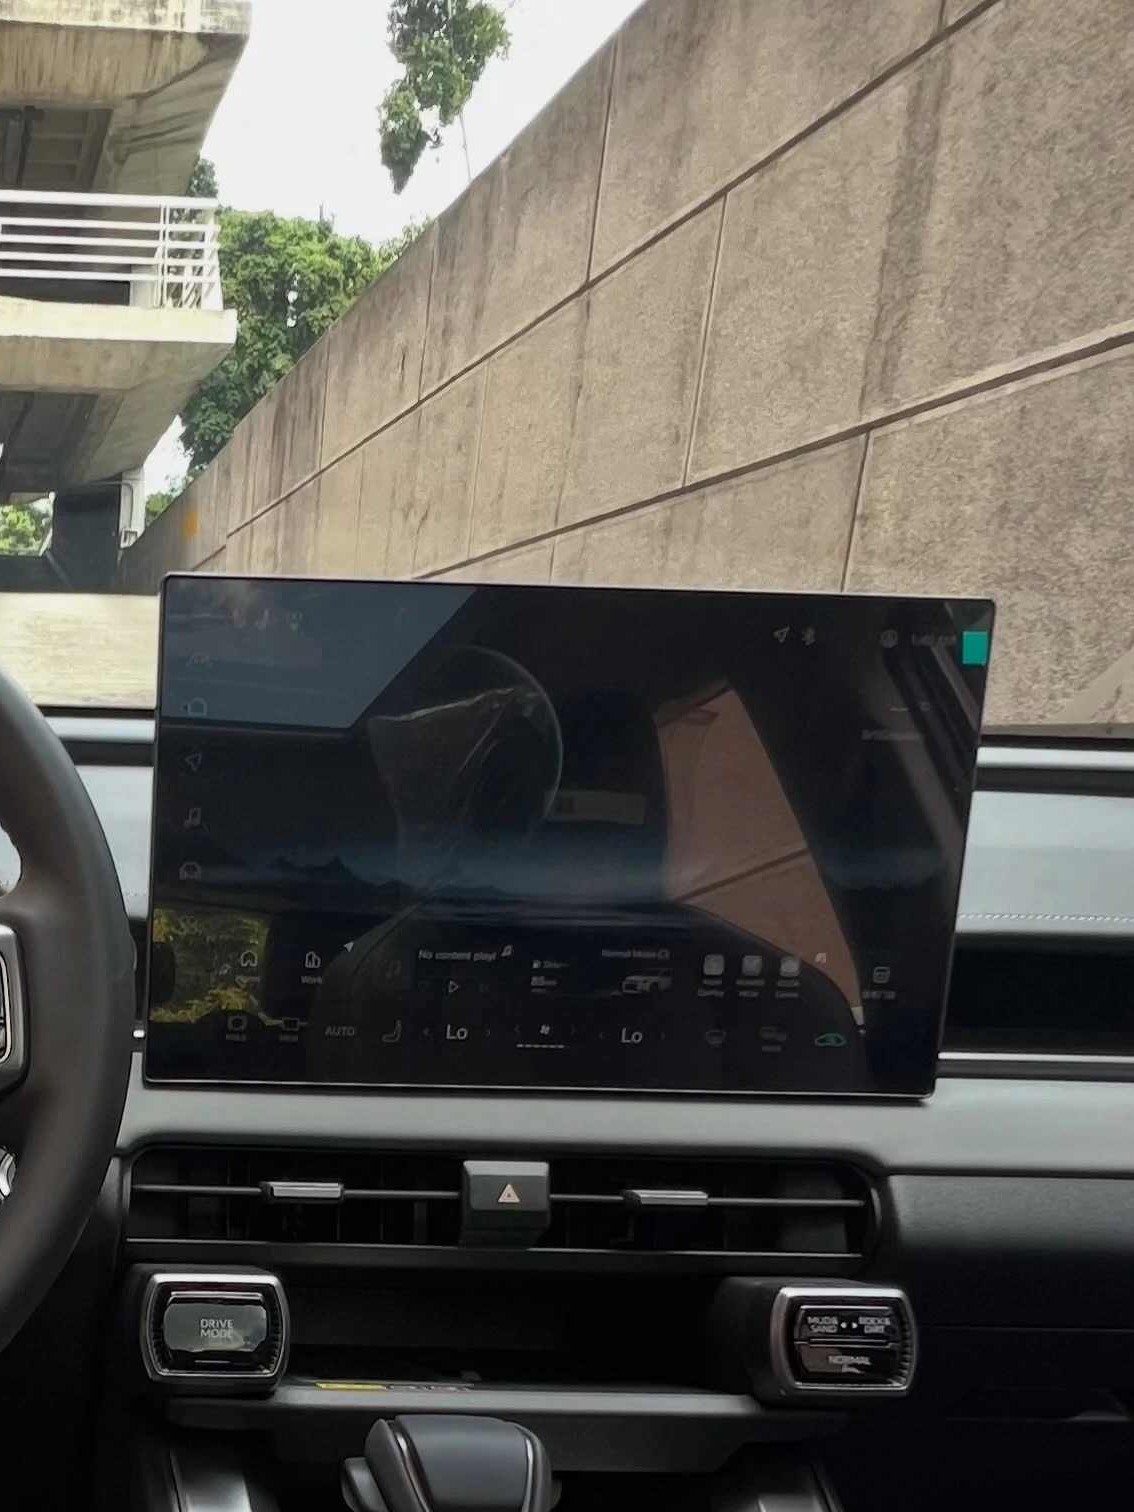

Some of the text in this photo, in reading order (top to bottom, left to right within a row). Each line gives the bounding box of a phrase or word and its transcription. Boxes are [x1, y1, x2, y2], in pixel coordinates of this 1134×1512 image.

[324, 1025, 356, 1037] AUTO
[446, 1024, 468, 1041] Lo
[620, 1027, 643, 1044] Lo
[200, 1318, 234, 1329] DRIVE
[200, 1328, 234, 1338] MODE
[809, 1325, 838, 1334] SAND
[864, 1325, 886, 1334] DIRT
[828, 1355, 872, 1366] NORMAL
